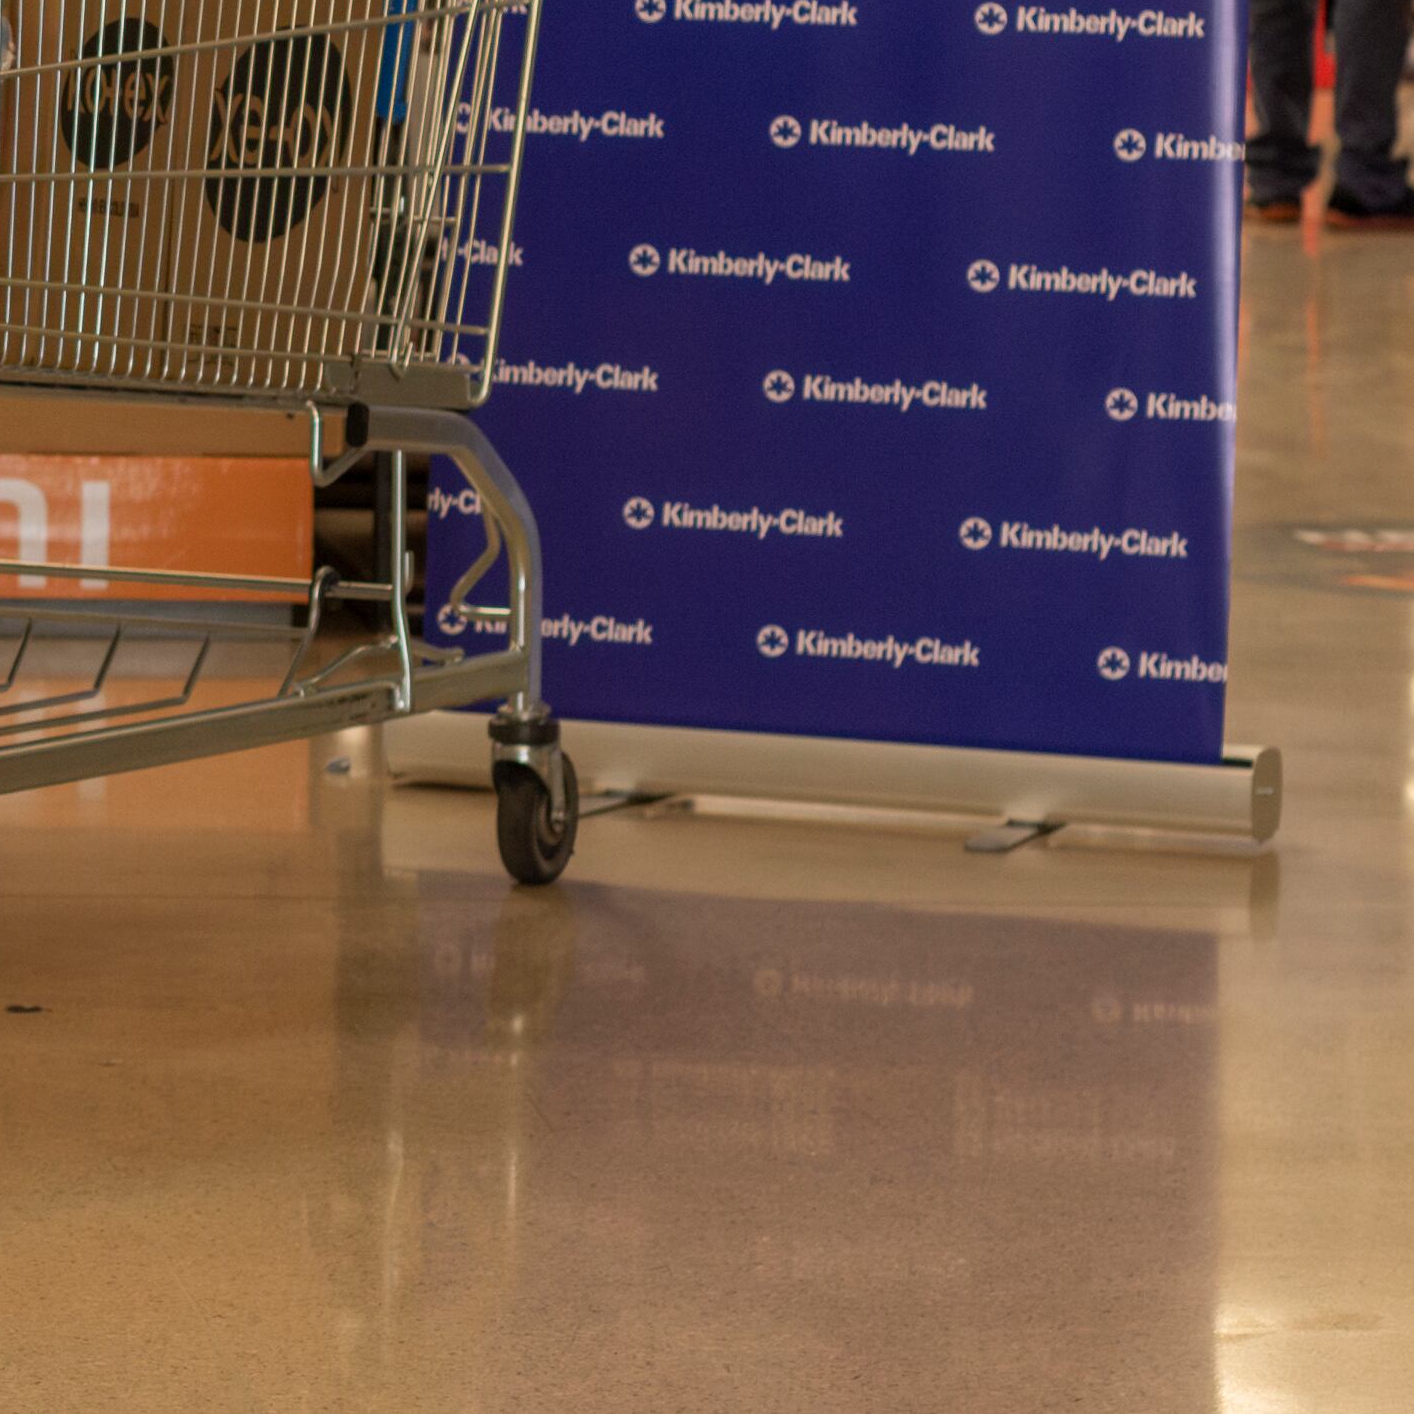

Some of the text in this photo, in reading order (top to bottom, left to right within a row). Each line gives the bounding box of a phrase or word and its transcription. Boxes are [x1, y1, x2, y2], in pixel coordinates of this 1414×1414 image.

[811, 120, 993, 153] Kimberly-Clark
[1009, 265, 1194, 299] Kimberly-Clark
[804, 375, 985, 410] Kimberly-Clark
[663, 502, 841, 538] Kimberly-Clark
[798, 630, 977, 666] Kimberly-Clark
